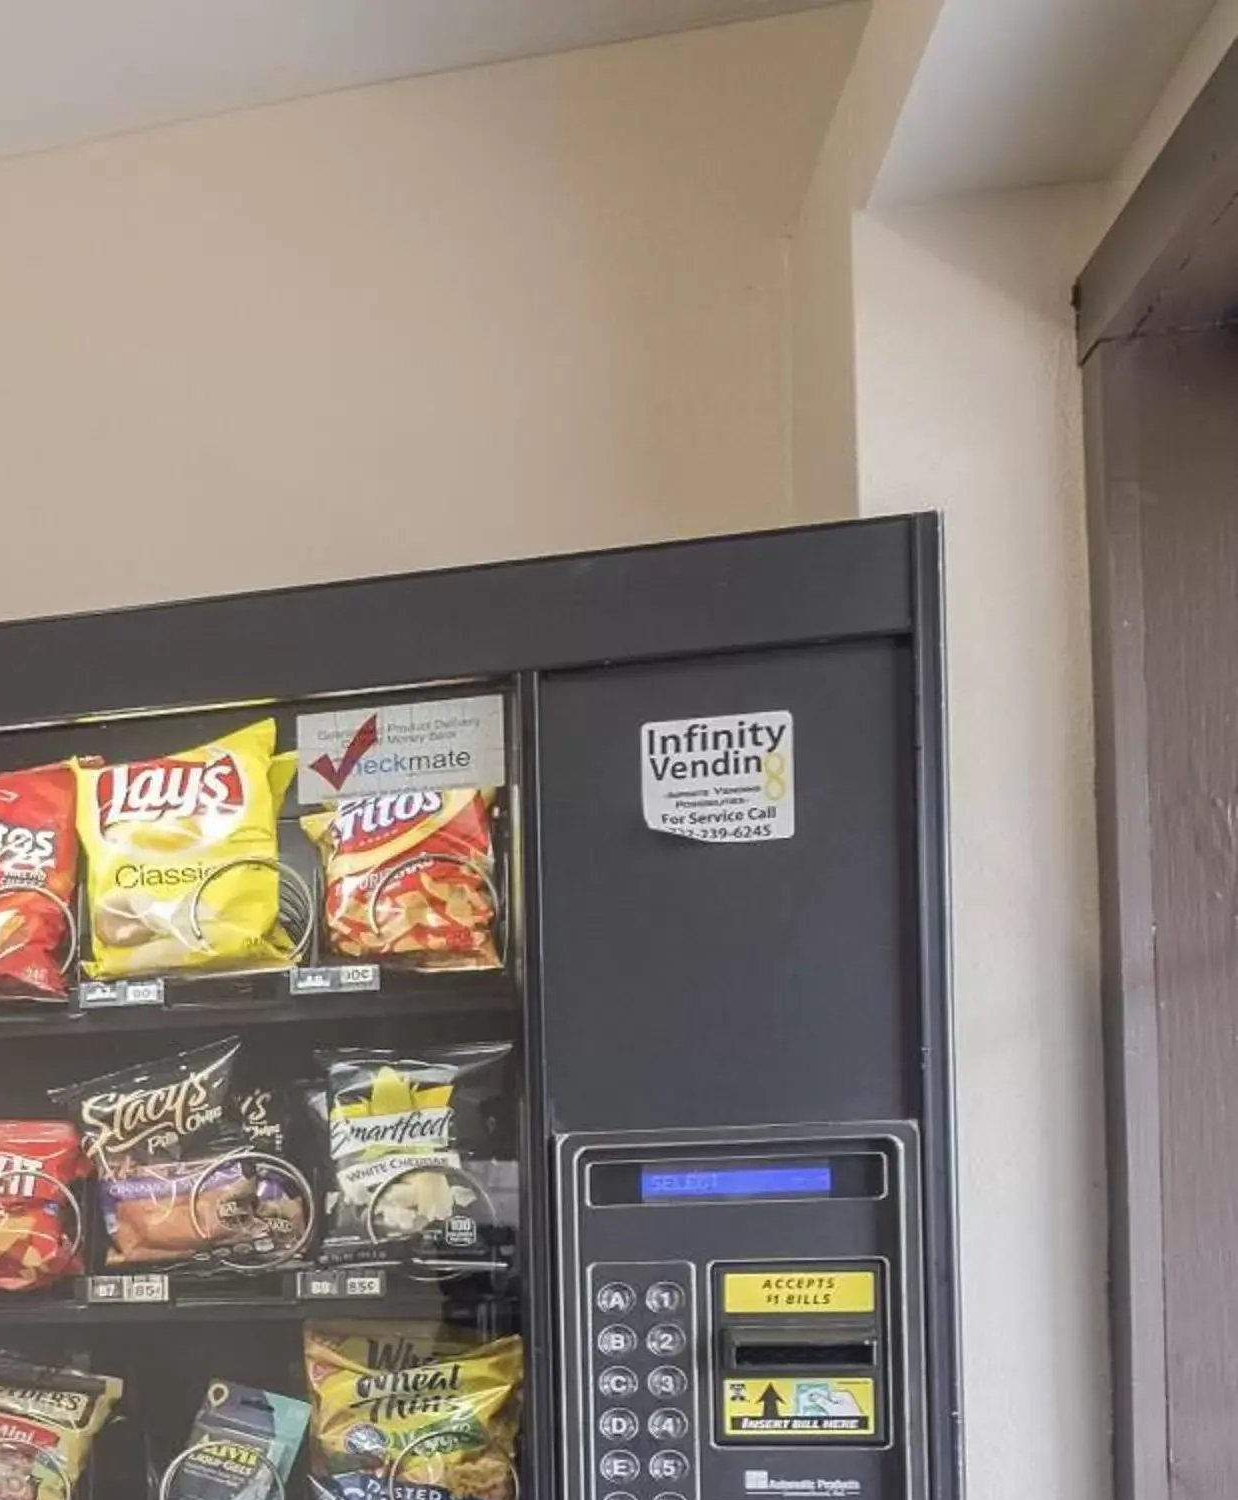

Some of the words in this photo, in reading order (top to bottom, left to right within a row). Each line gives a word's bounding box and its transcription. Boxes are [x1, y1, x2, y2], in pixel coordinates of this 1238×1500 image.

[387, 721, 431, 734] Product
[387, 733, 426, 745] Money
[647, 720, 786, 755] Infinity
[661, 813, 685, 825] For
[688, 809, 744, 825] Service
[747, 806, 777, 820] Call
[115, 863, 219, 889] Classic
[82, 1071, 210, 1157] Stacy's
[331, 1110, 455, 1153] Smartfood
[346, 1162, 388, 1182] WHITE
[762, 1277, 835, 1289] ACCEPTS
[611, 1291, 625, 1308] A
[662, 1291, 671, 1307] 1
[785, 1293, 831, 1305] BILLS
[612, 1334, 624, 1349] B
[661, 1334, 674, 1349] 2
[611, 1376, 626, 1391] C
[662, 1376, 674, 1391] 3
[612, 1418, 626, 1433] D
[661, 1417, 674, 1433] 4
[612, 1459, 627, 1475] E
[662, 1459, 675, 1476] 5
